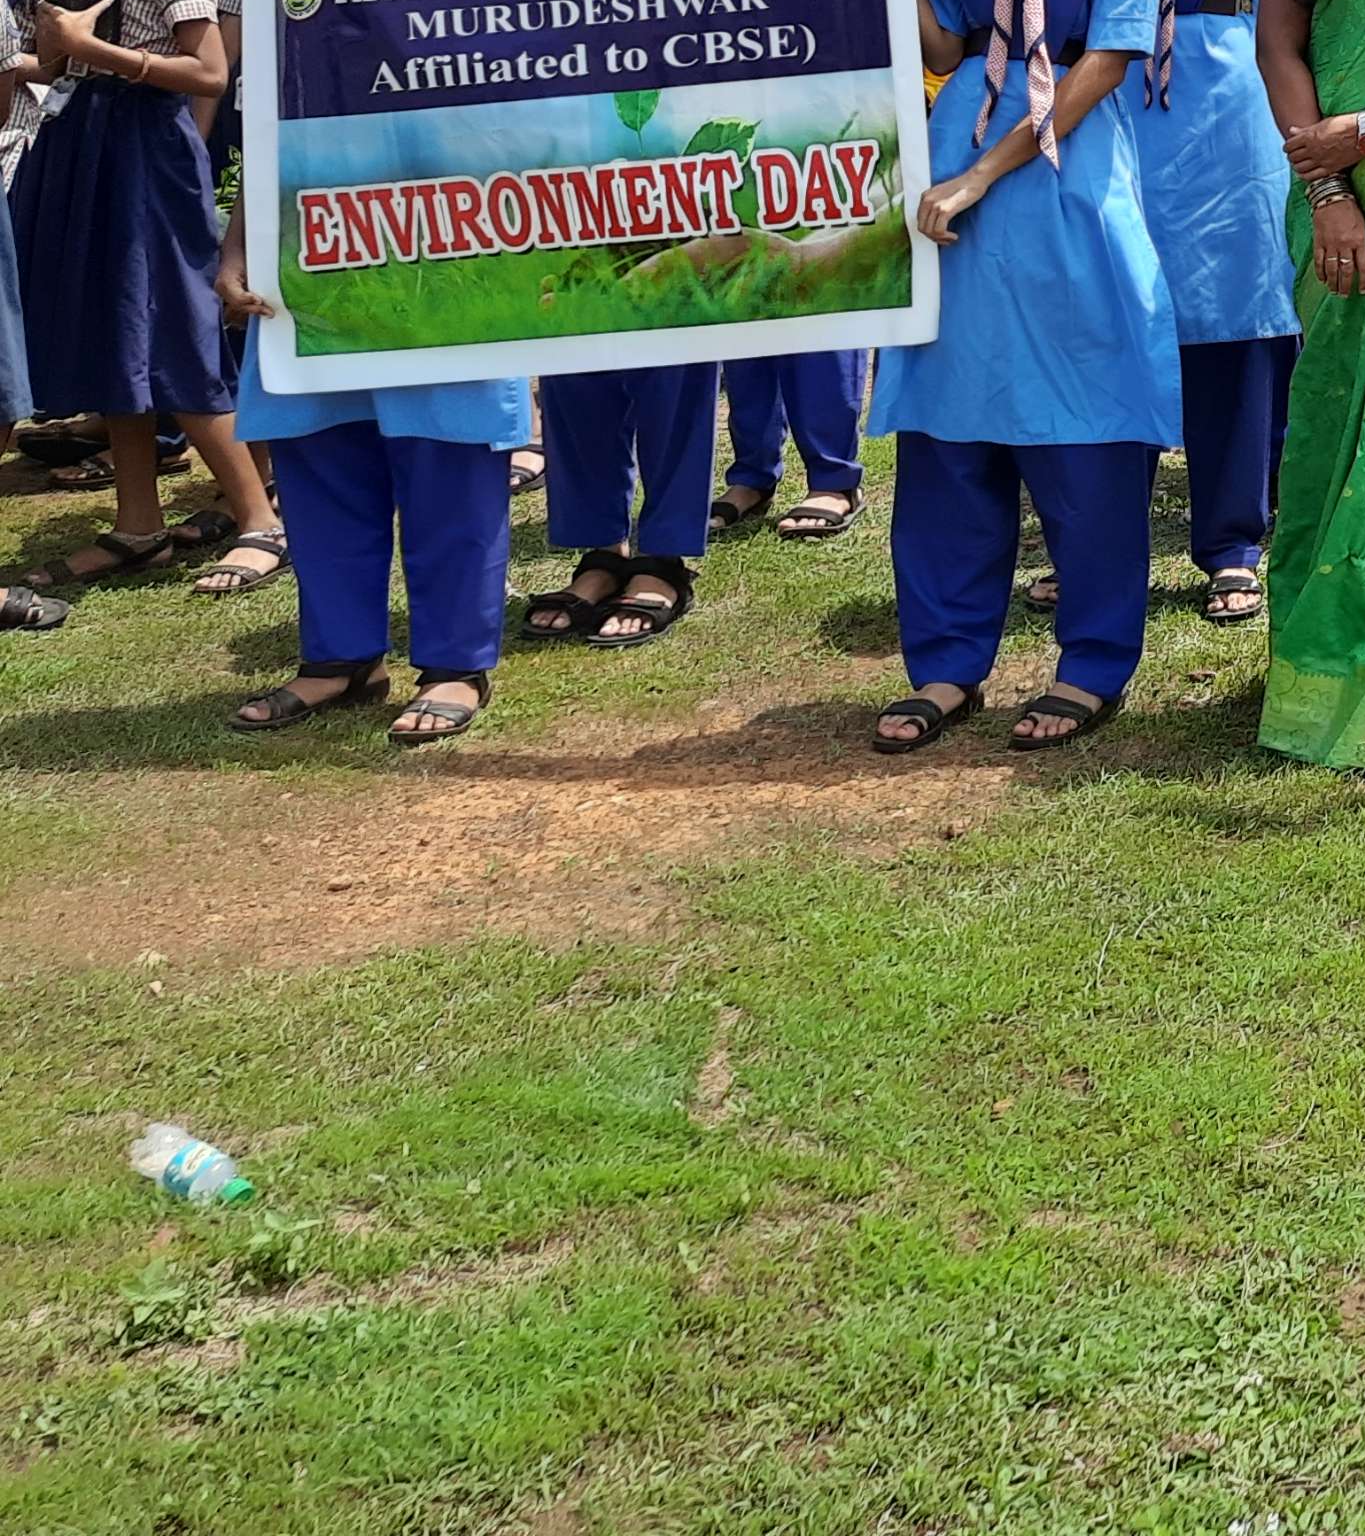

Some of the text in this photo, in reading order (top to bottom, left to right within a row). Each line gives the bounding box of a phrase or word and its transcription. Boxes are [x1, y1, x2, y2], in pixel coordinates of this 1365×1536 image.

[369, 24, 817, 94] Affiliated to CBSE)
[298, 140, 878, 270] ENVIRONMENT DAY
